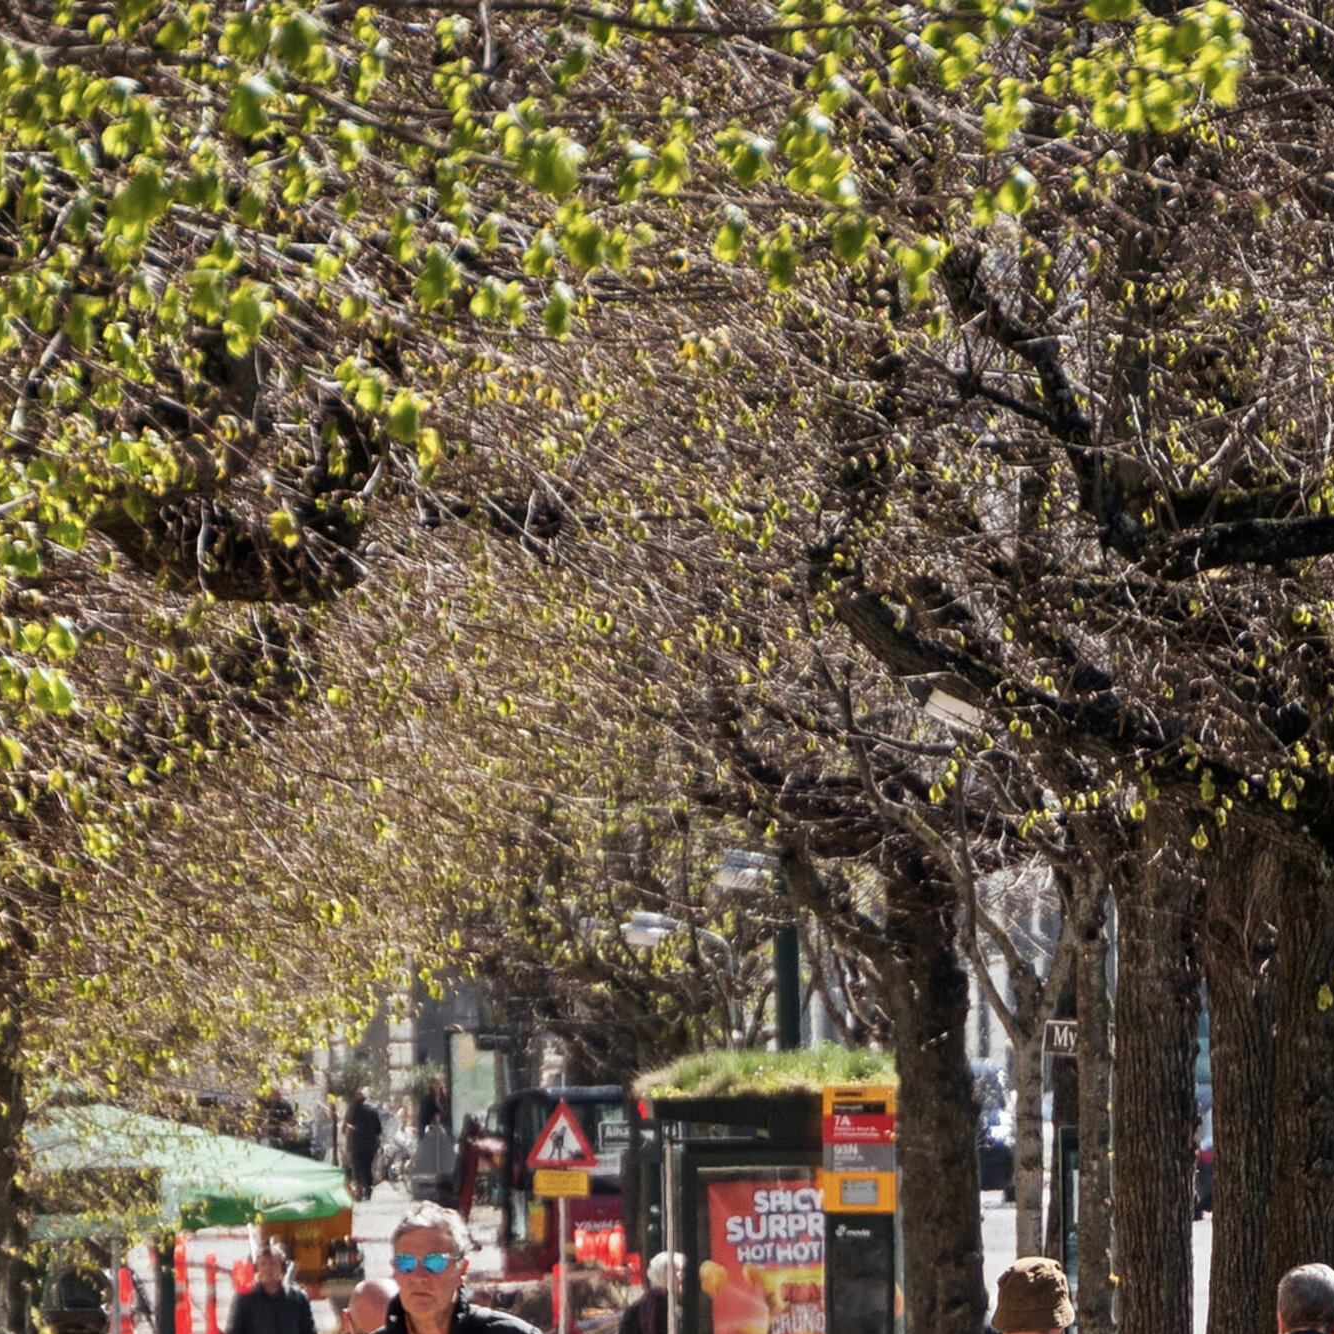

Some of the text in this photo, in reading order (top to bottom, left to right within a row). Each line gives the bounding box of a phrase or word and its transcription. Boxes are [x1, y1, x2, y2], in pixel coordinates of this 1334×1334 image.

[833, 1115, 851, 1127] 7A
[754, 1188, 825, 1213] SPICY
[726, 1212, 825, 1242] SURPR
[737, 1241, 824, 1263] HOT HOT
